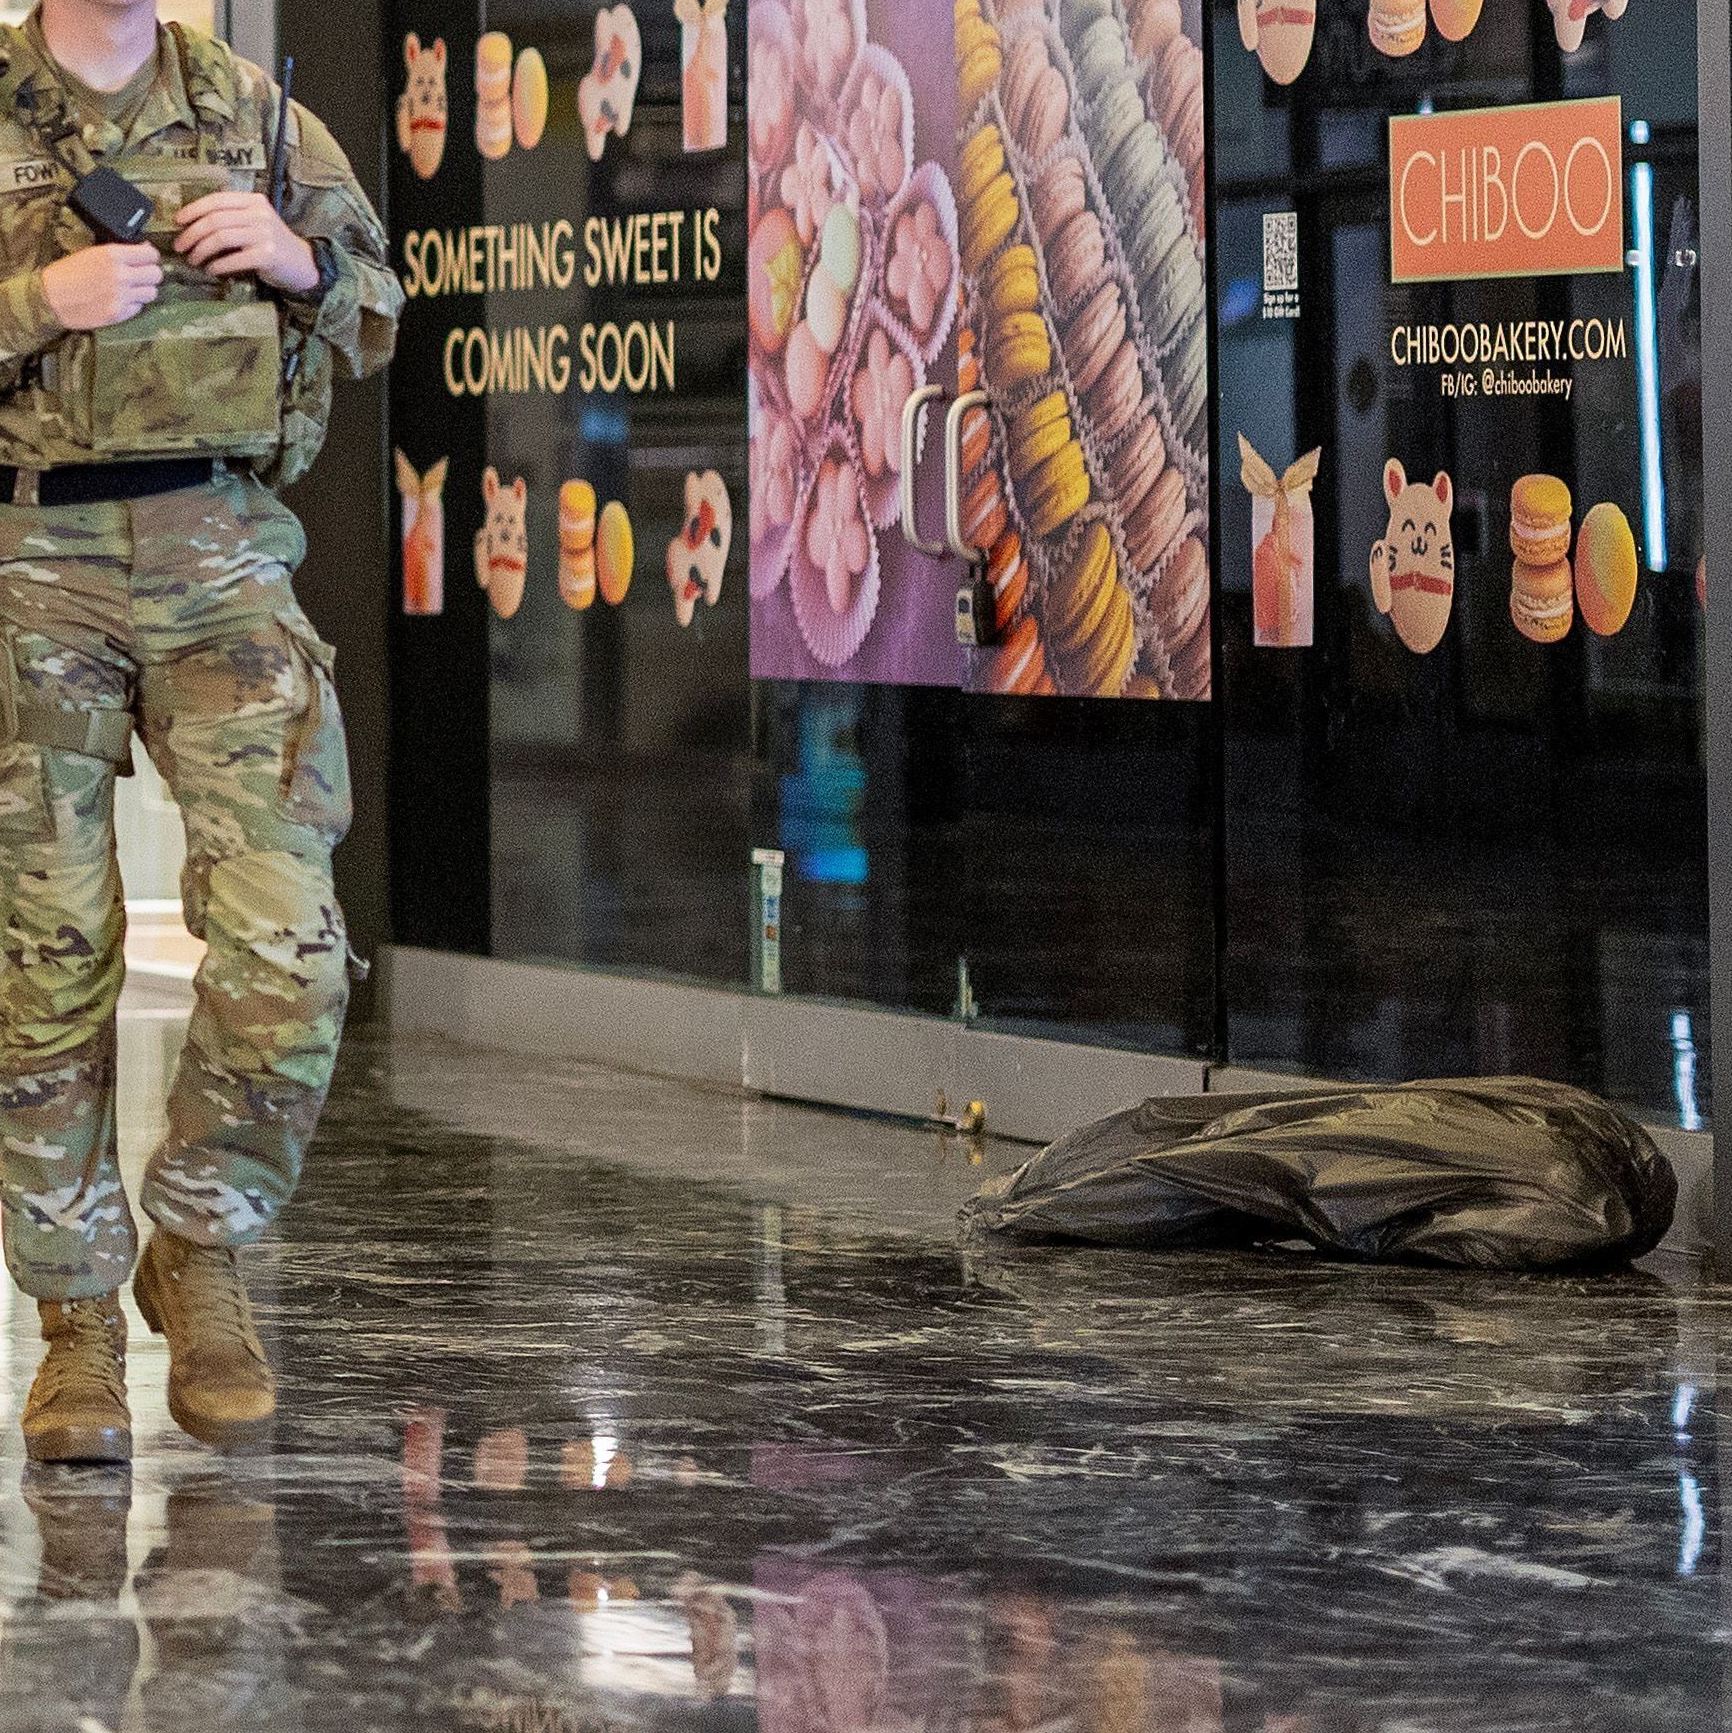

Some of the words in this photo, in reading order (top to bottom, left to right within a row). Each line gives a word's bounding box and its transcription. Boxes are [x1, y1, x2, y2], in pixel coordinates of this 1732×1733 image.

[1400, 136, 1612, 246] CHIBOO
[403, 218, 576, 299] SOMETHING
[584, 210, 685, 288] SWEET
[695, 208, 722, 282] IS
[444, 323, 573, 397] COMING
[579, 321, 676, 395] SOON
[1391, 317, 1627, 366] CHIBOOBAKERY.COM
[1440, 370, 1478, 399] FB/IG:
[1482, 368, 1573, 401] @chiboobakery
